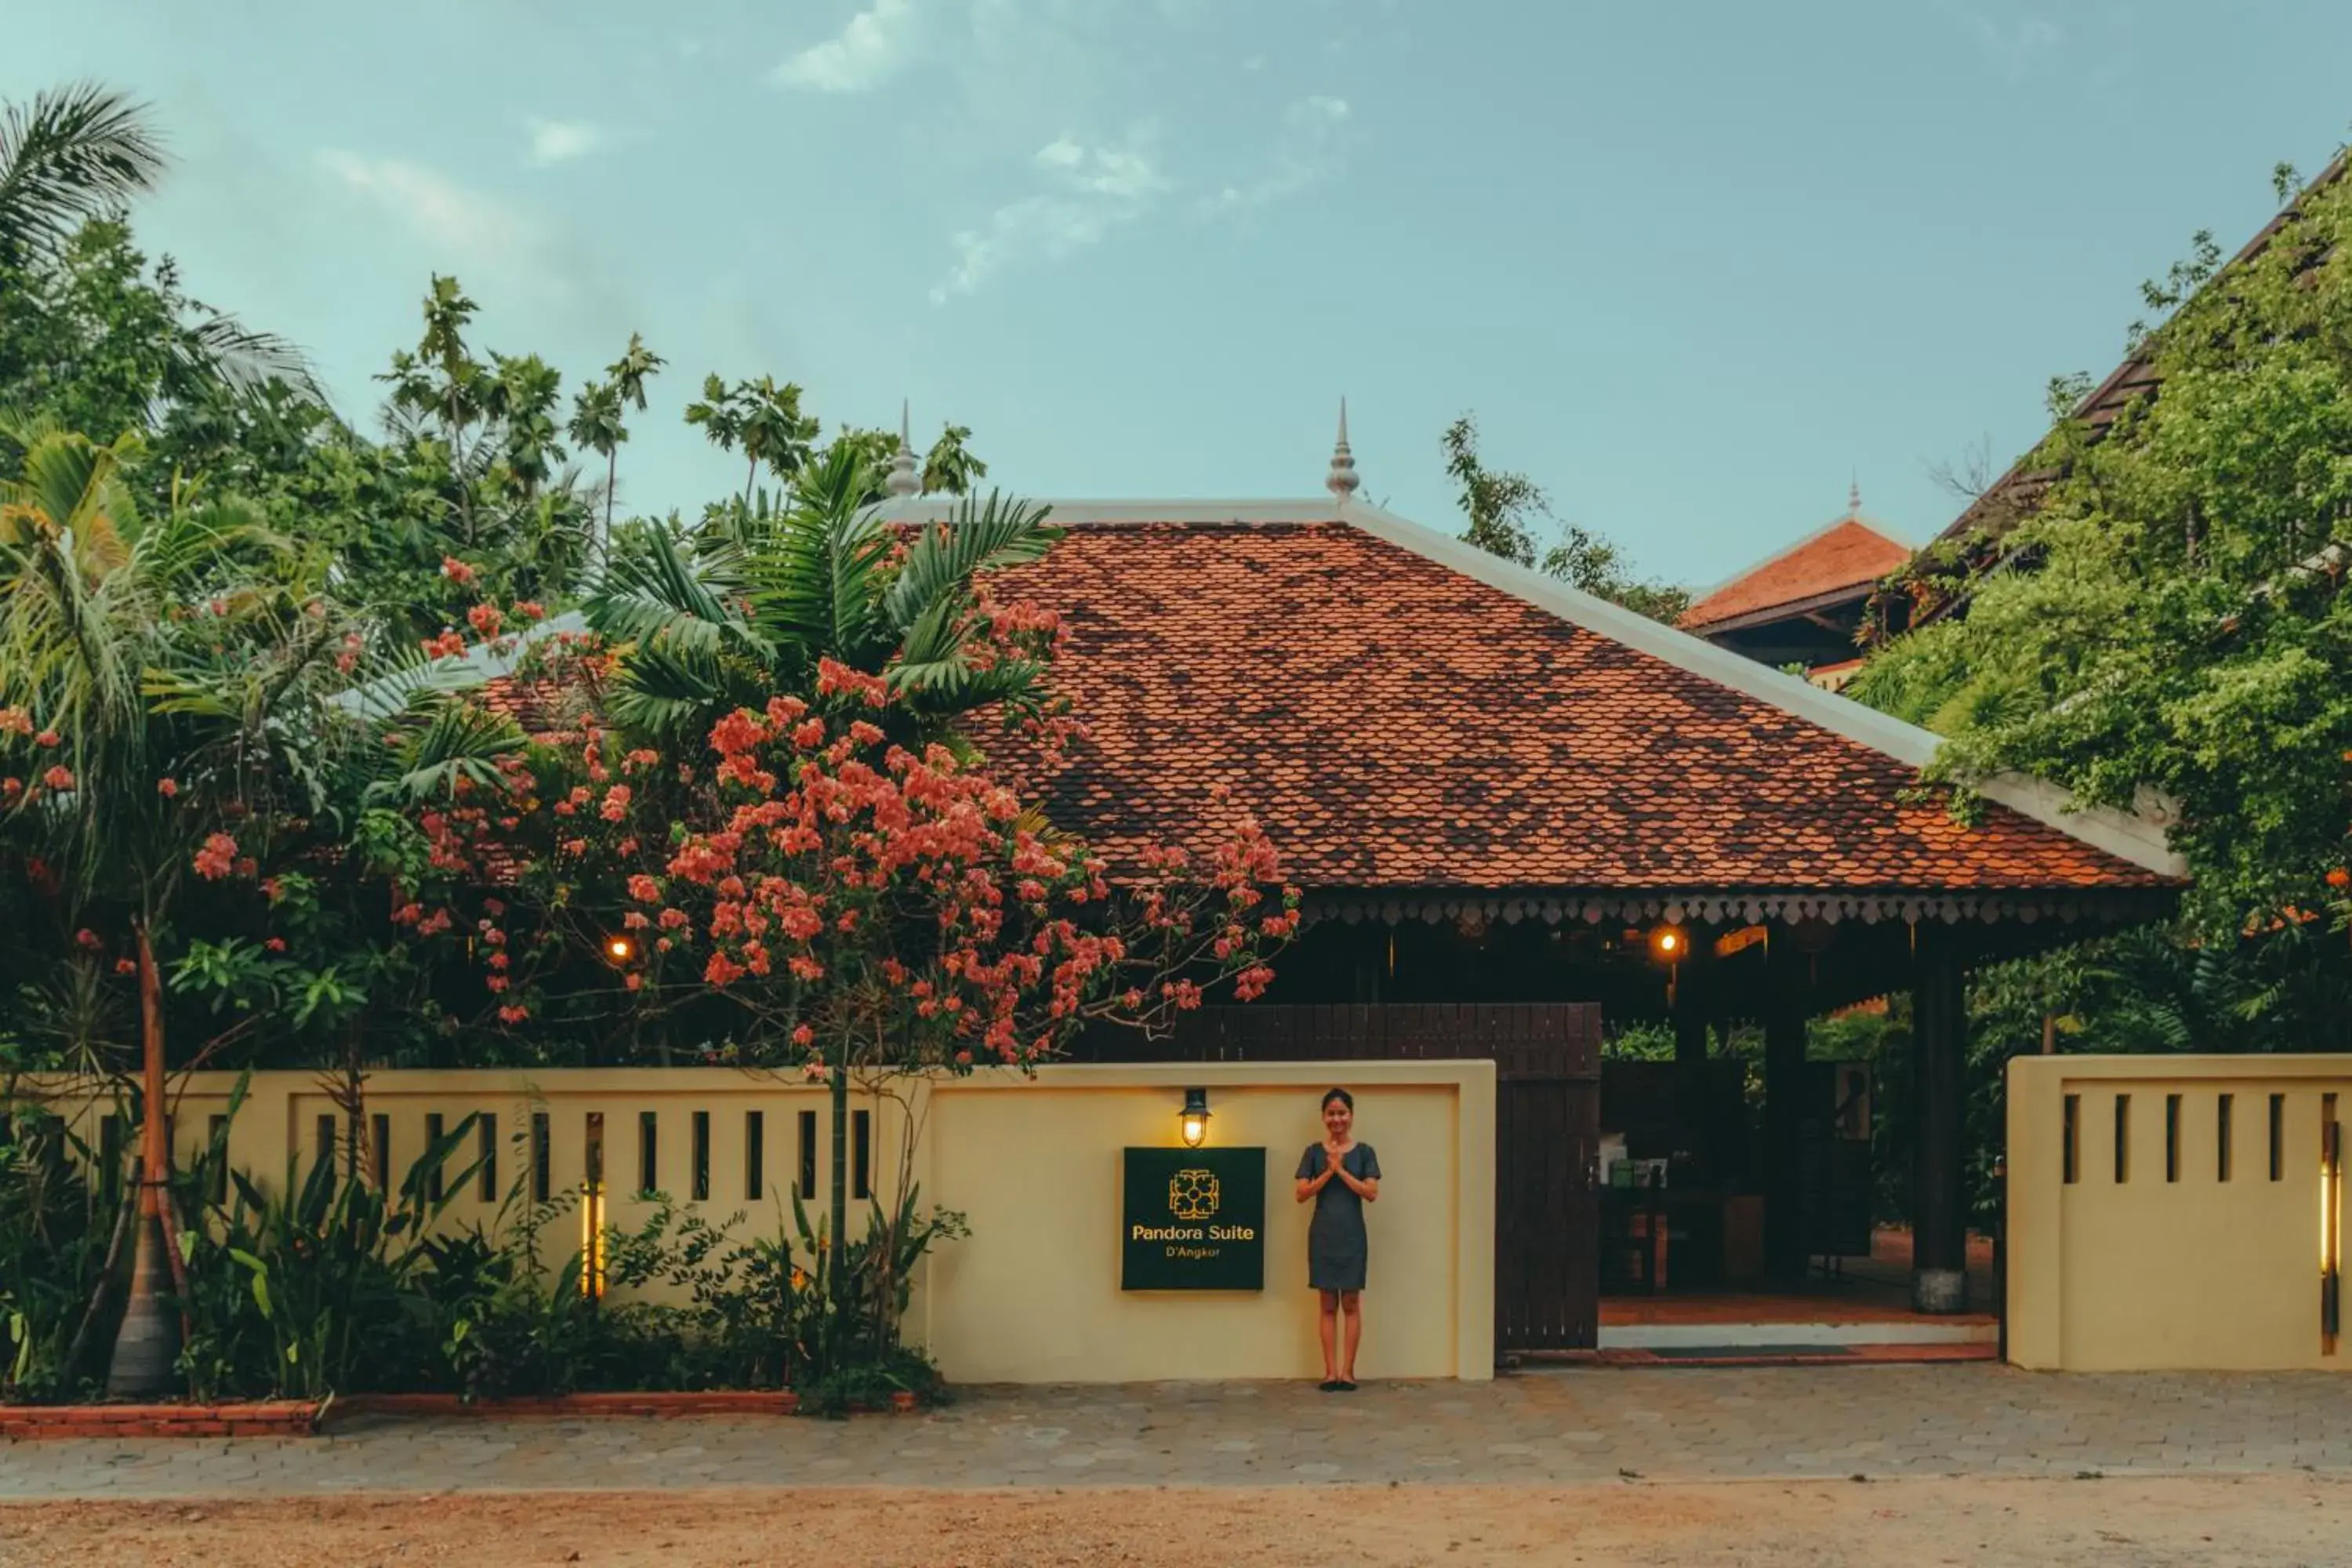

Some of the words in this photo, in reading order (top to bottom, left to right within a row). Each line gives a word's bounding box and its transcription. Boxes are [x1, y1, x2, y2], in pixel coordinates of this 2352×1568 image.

[1132, 1225, 1203, 1240] Pandora
[1208, 1225, 1254, 1240] Suite
[1166, 1246, 1221, 1260] D'Angkor
